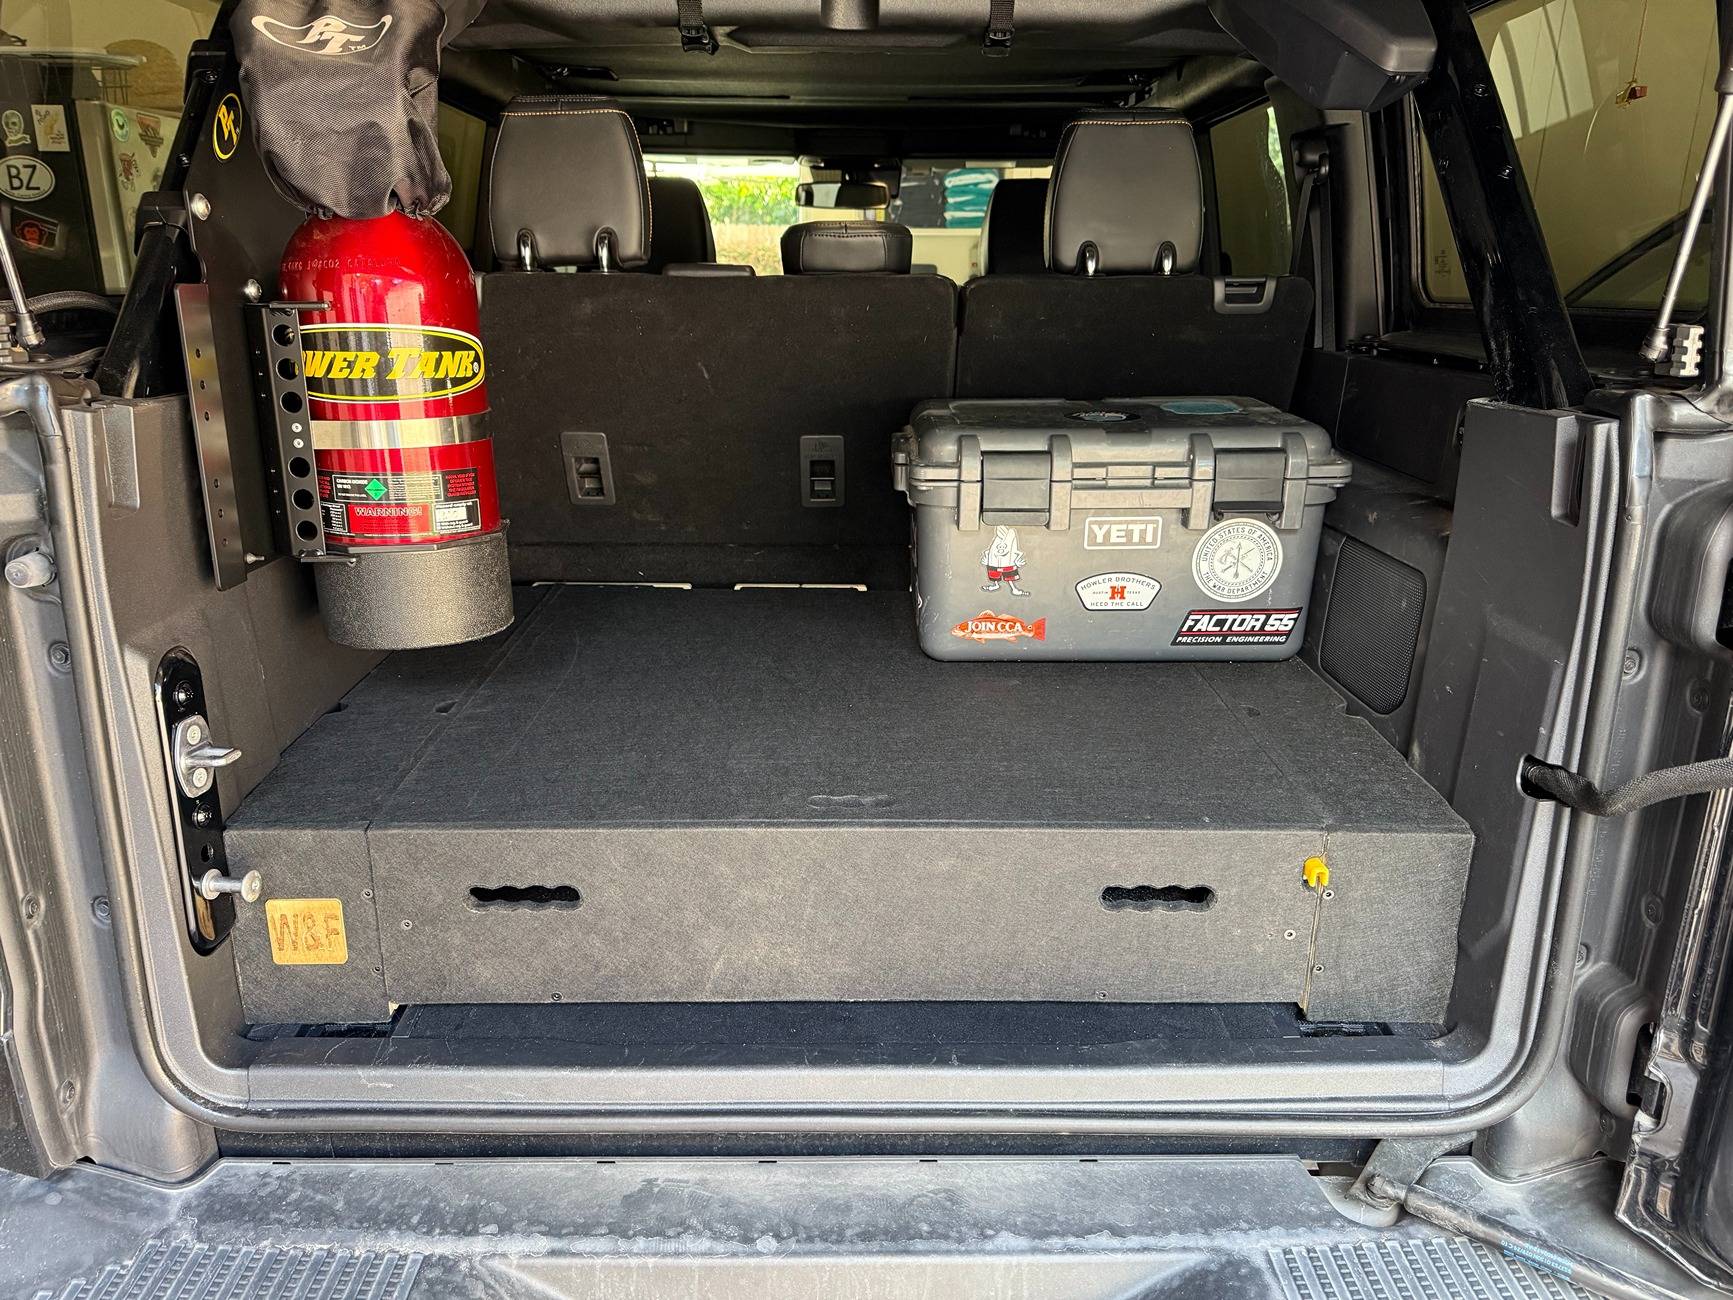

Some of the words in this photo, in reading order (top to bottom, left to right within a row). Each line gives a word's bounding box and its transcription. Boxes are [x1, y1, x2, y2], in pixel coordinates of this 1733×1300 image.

[6, 164, 41, 191] BZ
[302, 350, 381, 379] WER
[386, 347, 476, 380] TANK
[354, 506, 423, 517] WARNING!
[1090, 523, 1155, 544] YETI
[1201, 537, 1219, 562] UNITED
[1218, 526, 1246, 539] STATES
[1247, 528, 1258, 536] OF
[1257, 533, 1274, 562] AMERICA
[1080, 577, 1113, 591] HOWLER
[1115, 576, 1157, 591] BROTHERS
[1203, 571, 1214, 584] THE
[1226, 570, 1269, 595] DEPARTMENT
[1109, 585, 1127, 600] H
[966, 621, 996, 633] JOIN
[996, 621, 1024, 633] CCA
[1181, 614, 1267, 632] FACTOR
[1263, 613, 1299, 632] 55
[1225, 635, 1288, 643] ENGINEERING
